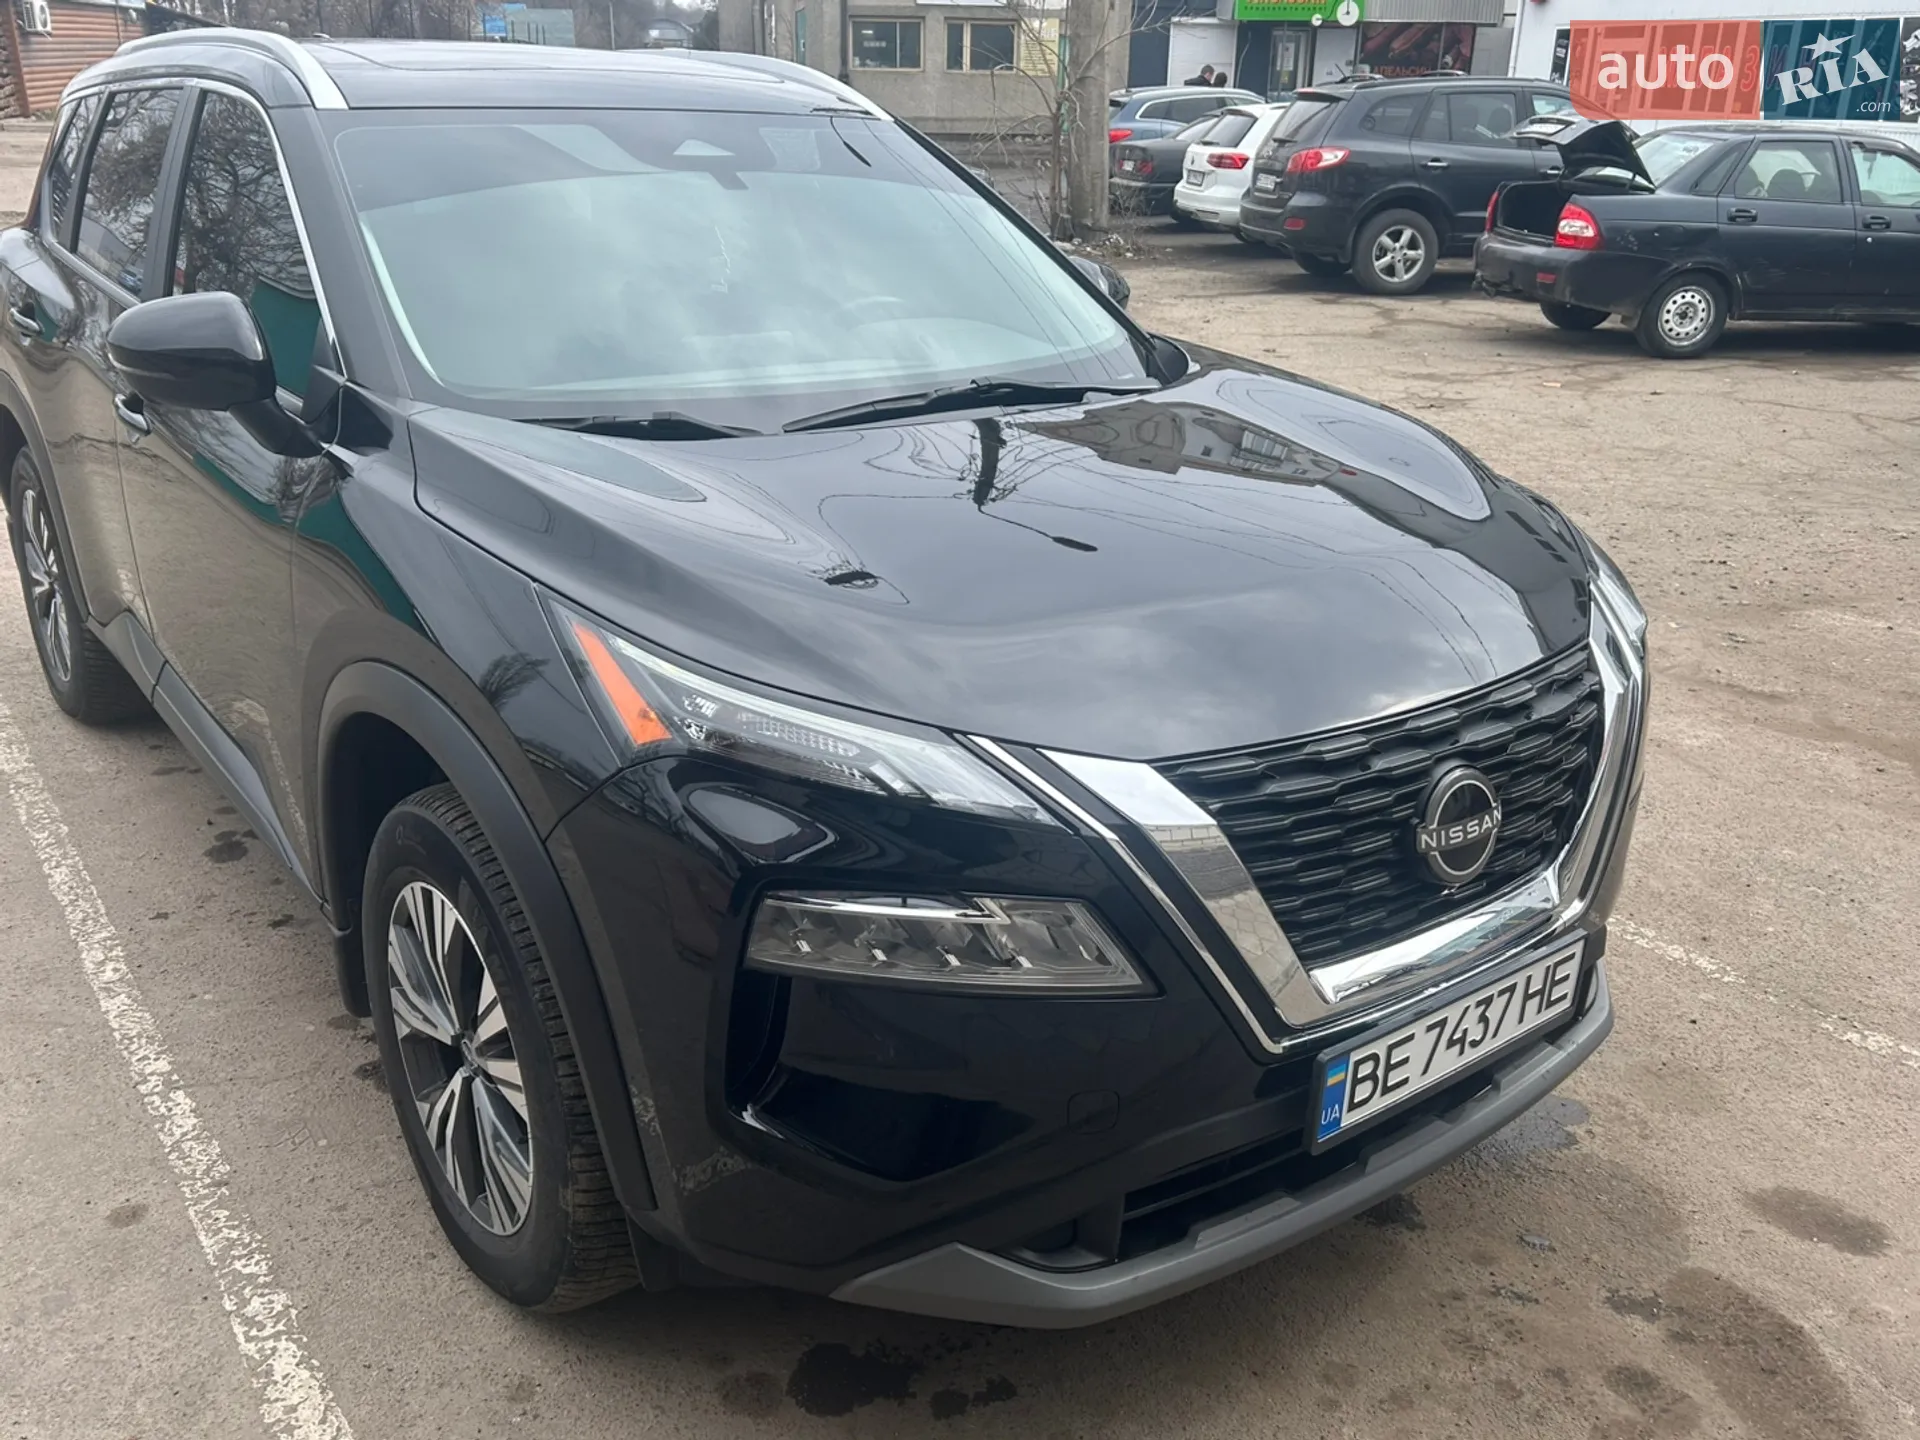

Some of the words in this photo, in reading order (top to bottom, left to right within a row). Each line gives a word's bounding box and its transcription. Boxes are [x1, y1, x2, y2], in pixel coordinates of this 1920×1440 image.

[1421, 804, 1501, 849] NISSAN
[1347, 1032, 1415, 1114] BE
[1420, 982, 1517, 1076] 7437
[1518, 952, 1576, 1025] HE
[1321, 1110, 1340, 1125] UA
